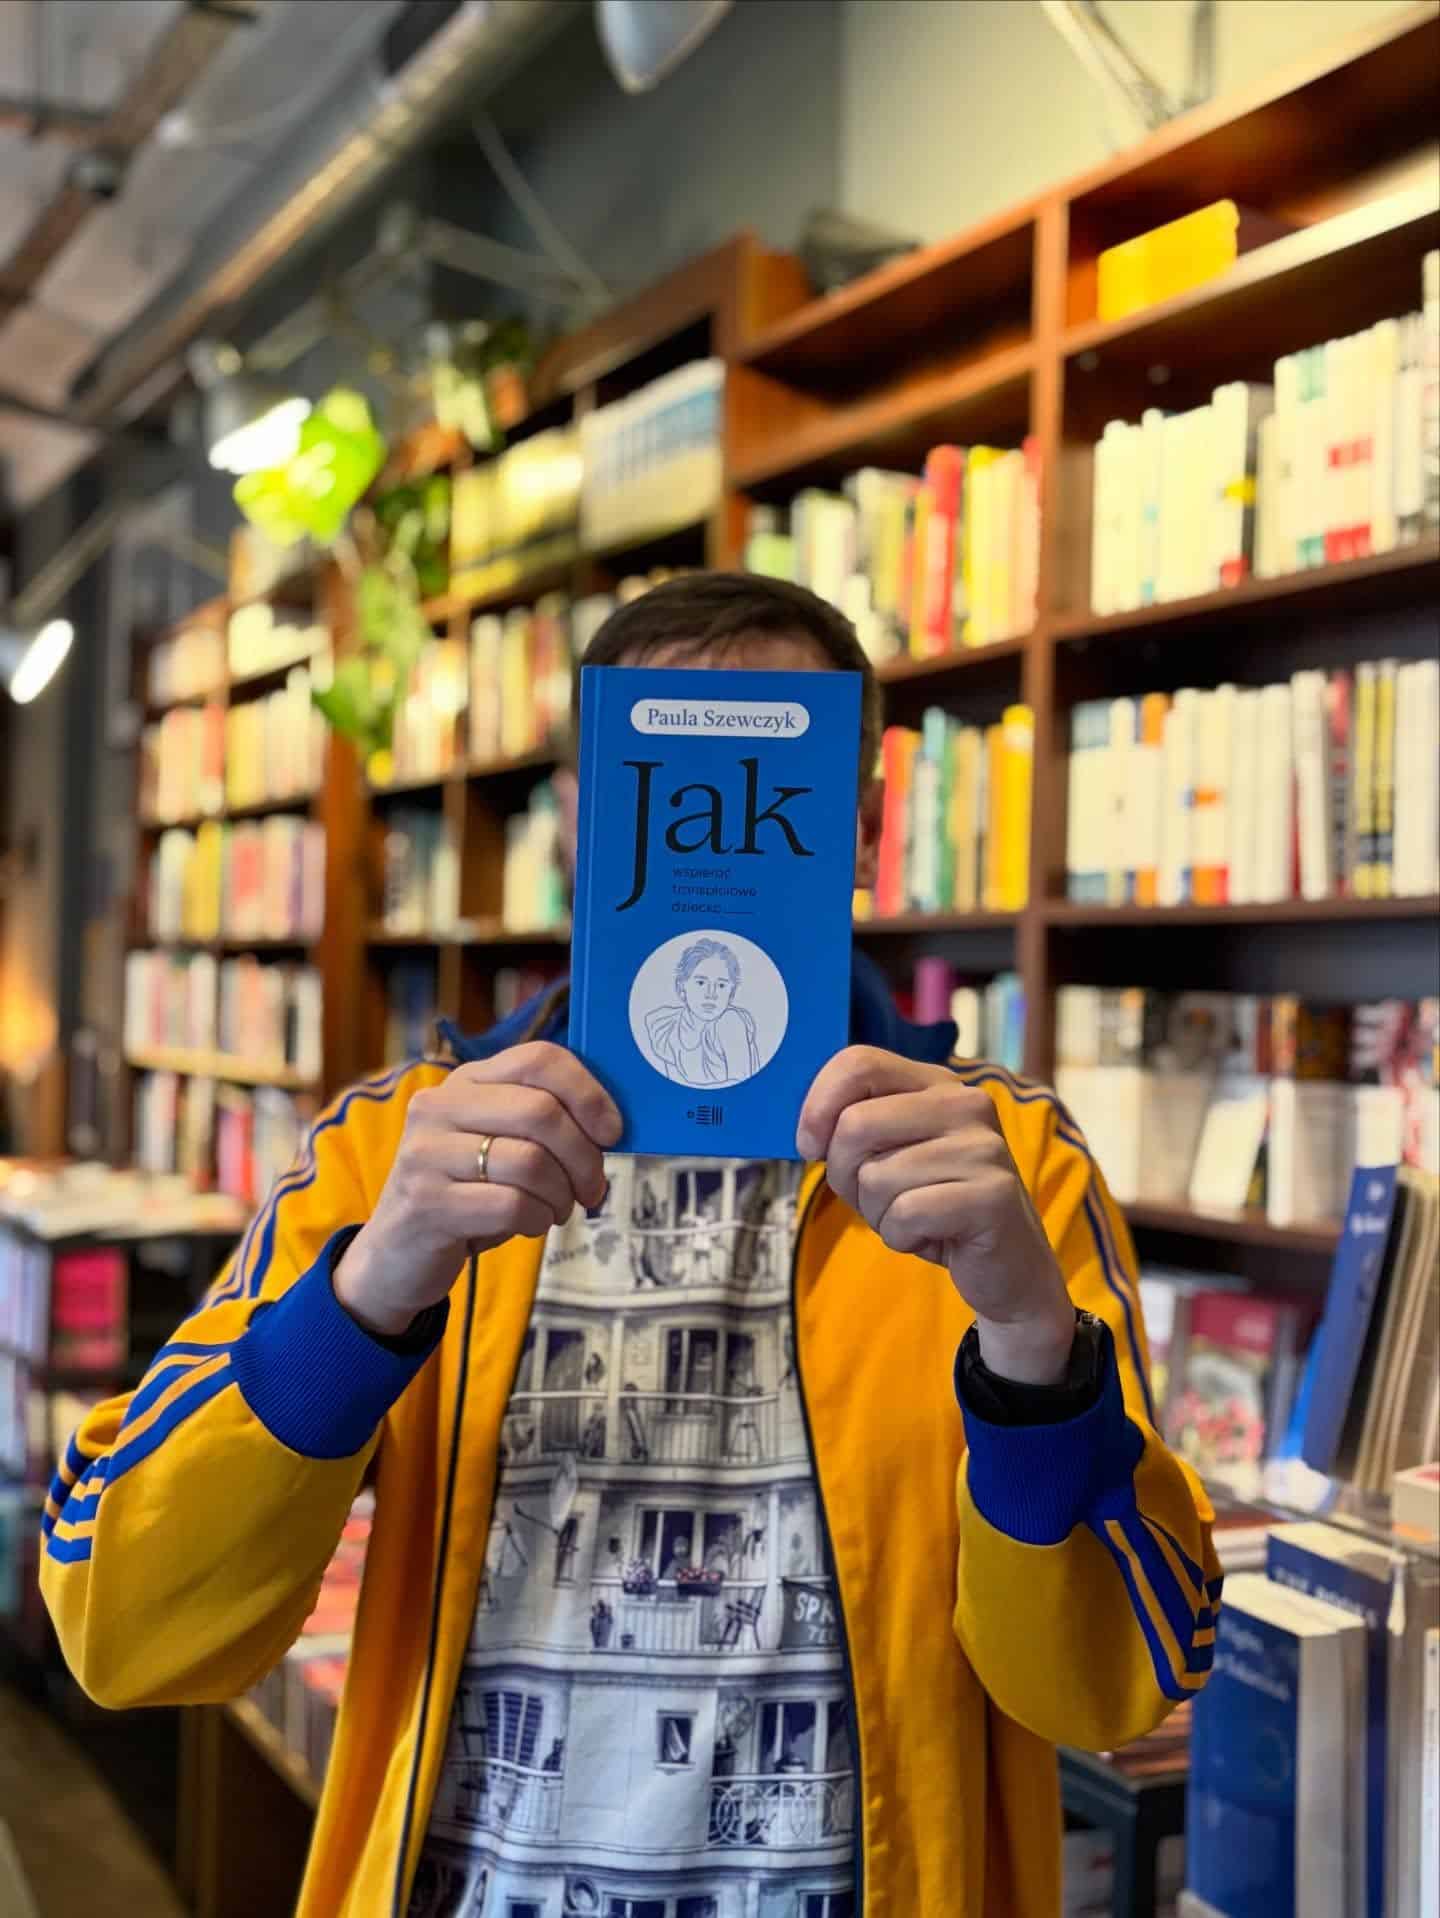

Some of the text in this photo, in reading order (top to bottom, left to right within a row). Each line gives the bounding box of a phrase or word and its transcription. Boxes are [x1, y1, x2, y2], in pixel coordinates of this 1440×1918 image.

[647, 708, 797, 733] Paula Szewczyk
[615, 757, 816, 913] Jak
